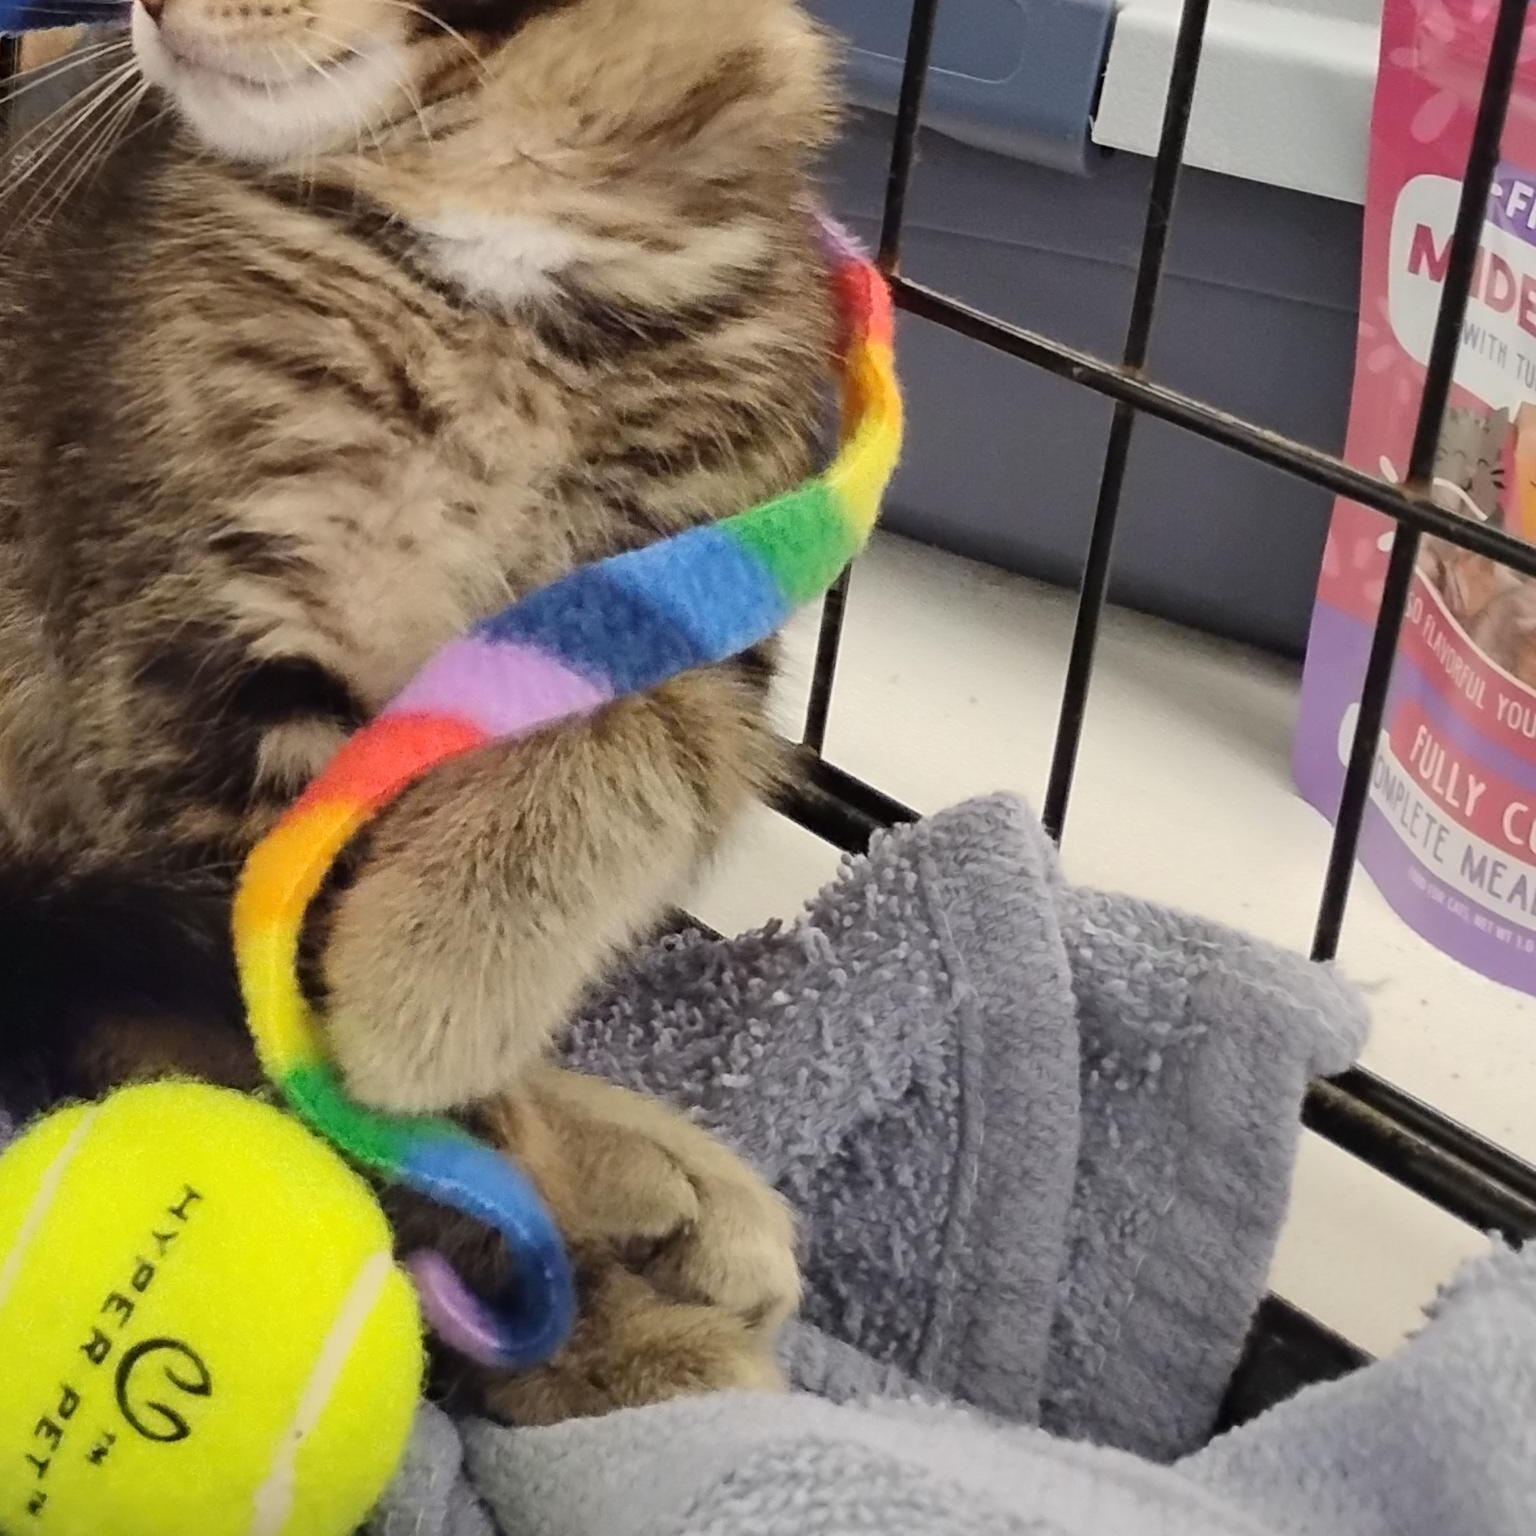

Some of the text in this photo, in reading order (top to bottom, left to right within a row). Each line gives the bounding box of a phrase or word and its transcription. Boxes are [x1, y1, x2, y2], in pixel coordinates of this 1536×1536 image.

[1463, 321, 1536, 391] WITH TU
[1422, 613, 1485, 711] FLAVORFUL
[1371, 754, 1450, 865] OMPLETE
[1409, 724, 1536, 855] FULLY C
[79, 1183, 203, 1366] HYPER
